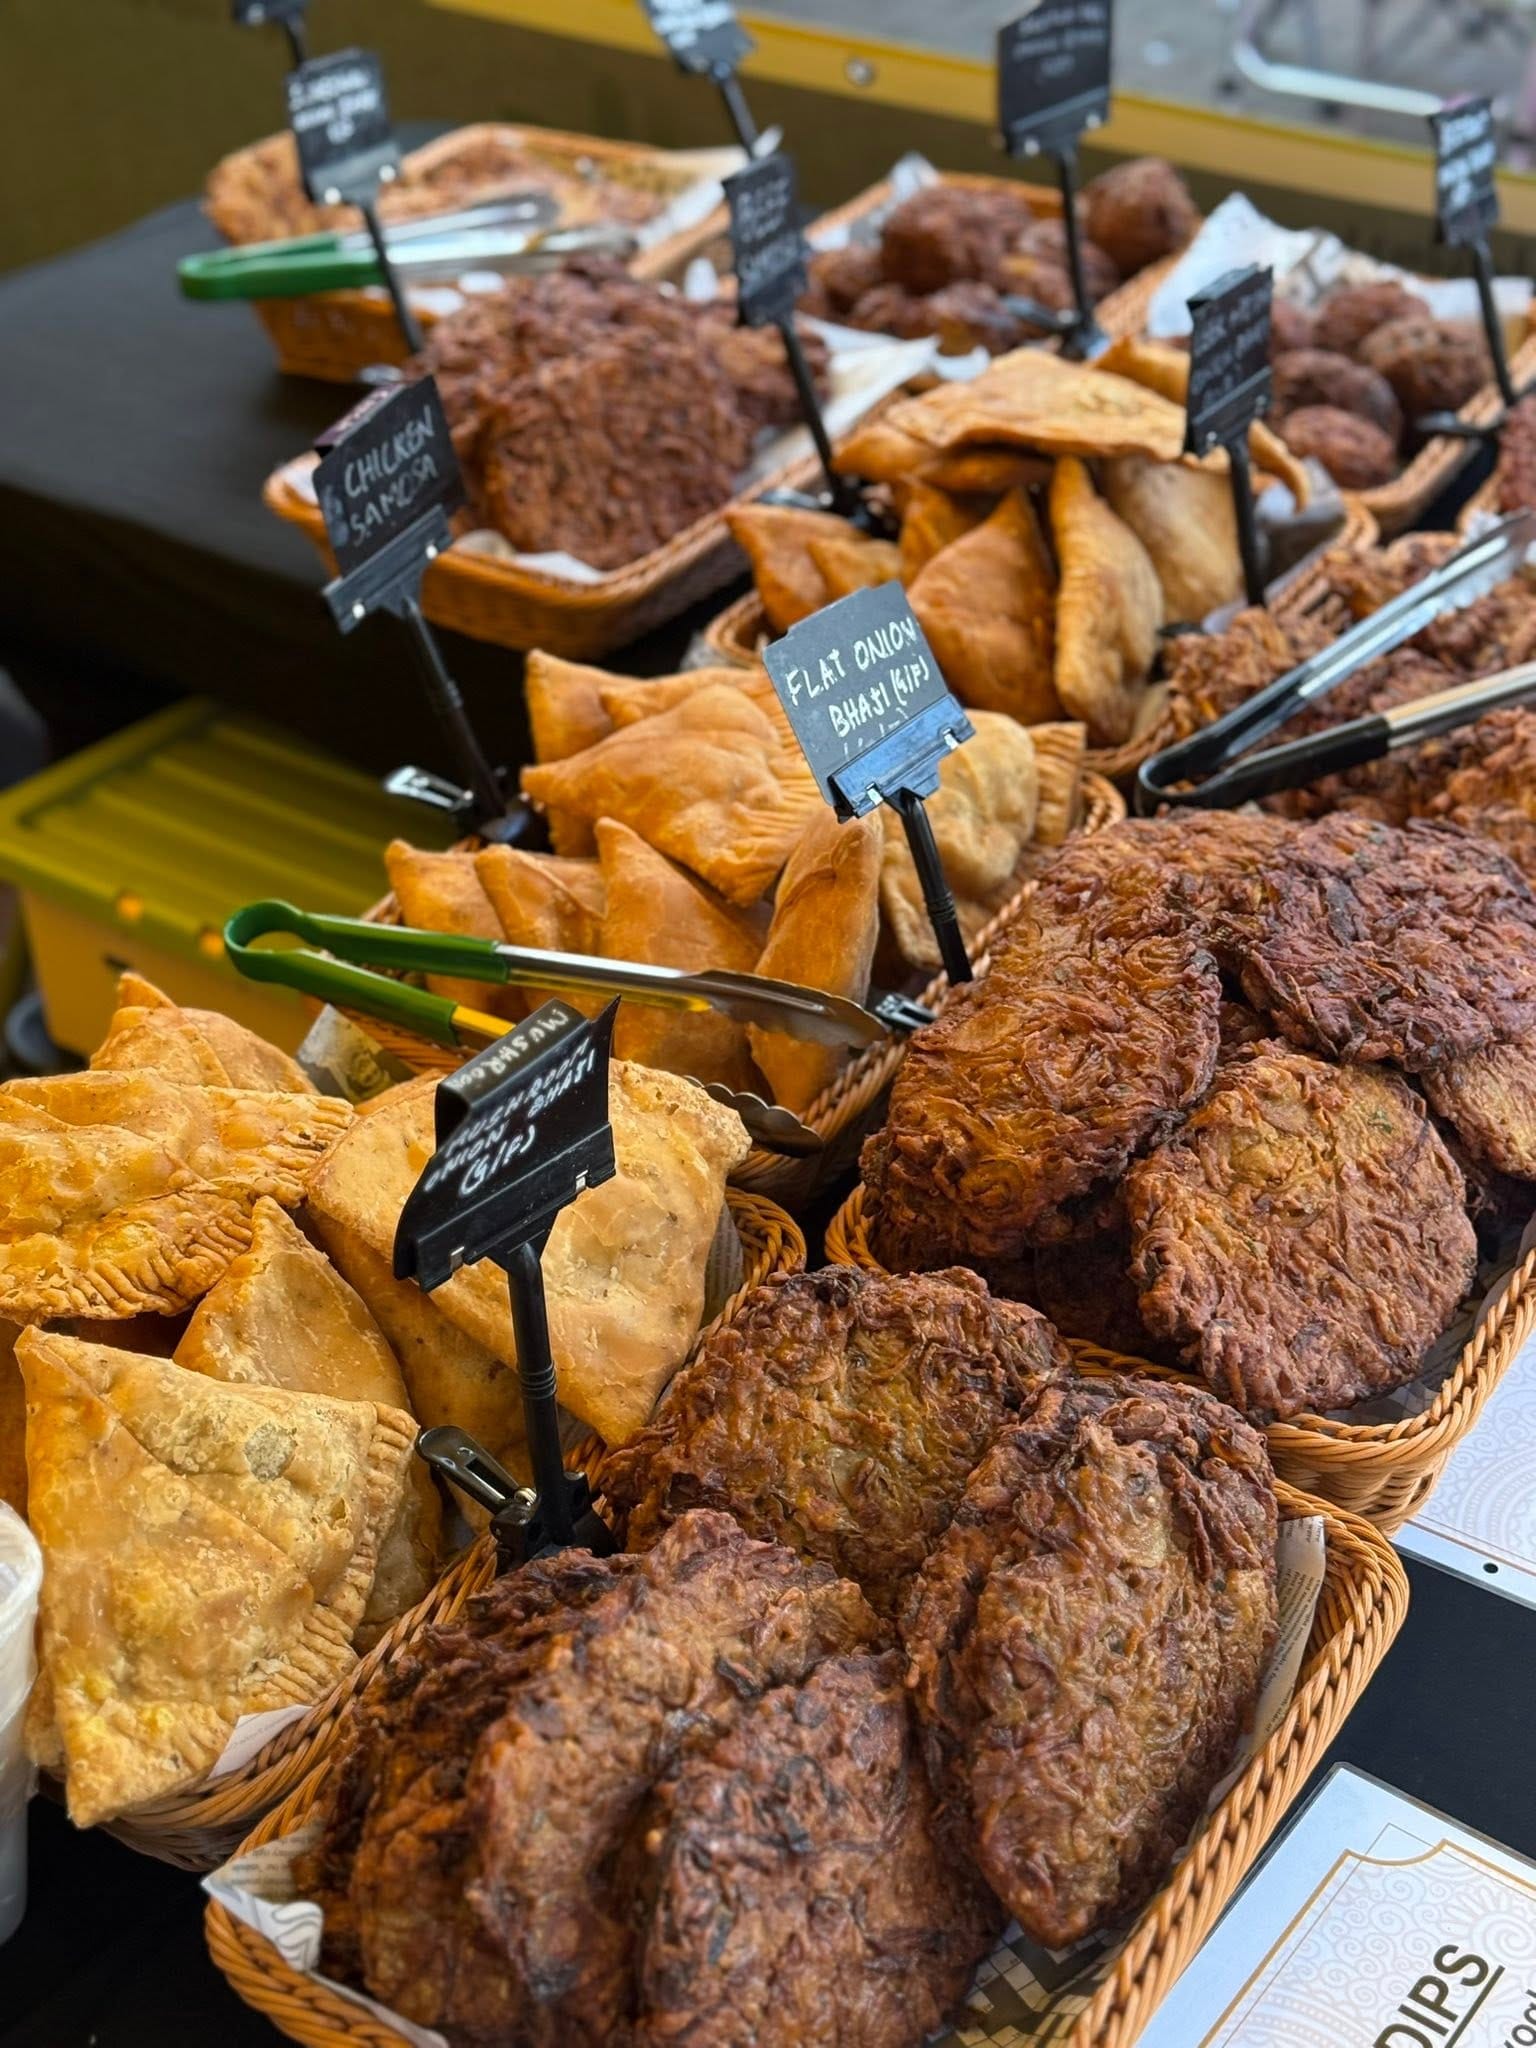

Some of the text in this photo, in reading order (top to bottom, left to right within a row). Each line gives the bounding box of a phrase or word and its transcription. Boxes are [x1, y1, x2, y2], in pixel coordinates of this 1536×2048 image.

[344, 405, 435, 498] CHICKEN
[351, 453, 439, 547] SAMOSA
[785, 617, 916, 706] FLAT ONION
[829, 682, 891, 738] BHAJI
[424, 1049, 595, 1192] ONION BHAJI
[1373, 1944, 1489, 2048] DIPS
